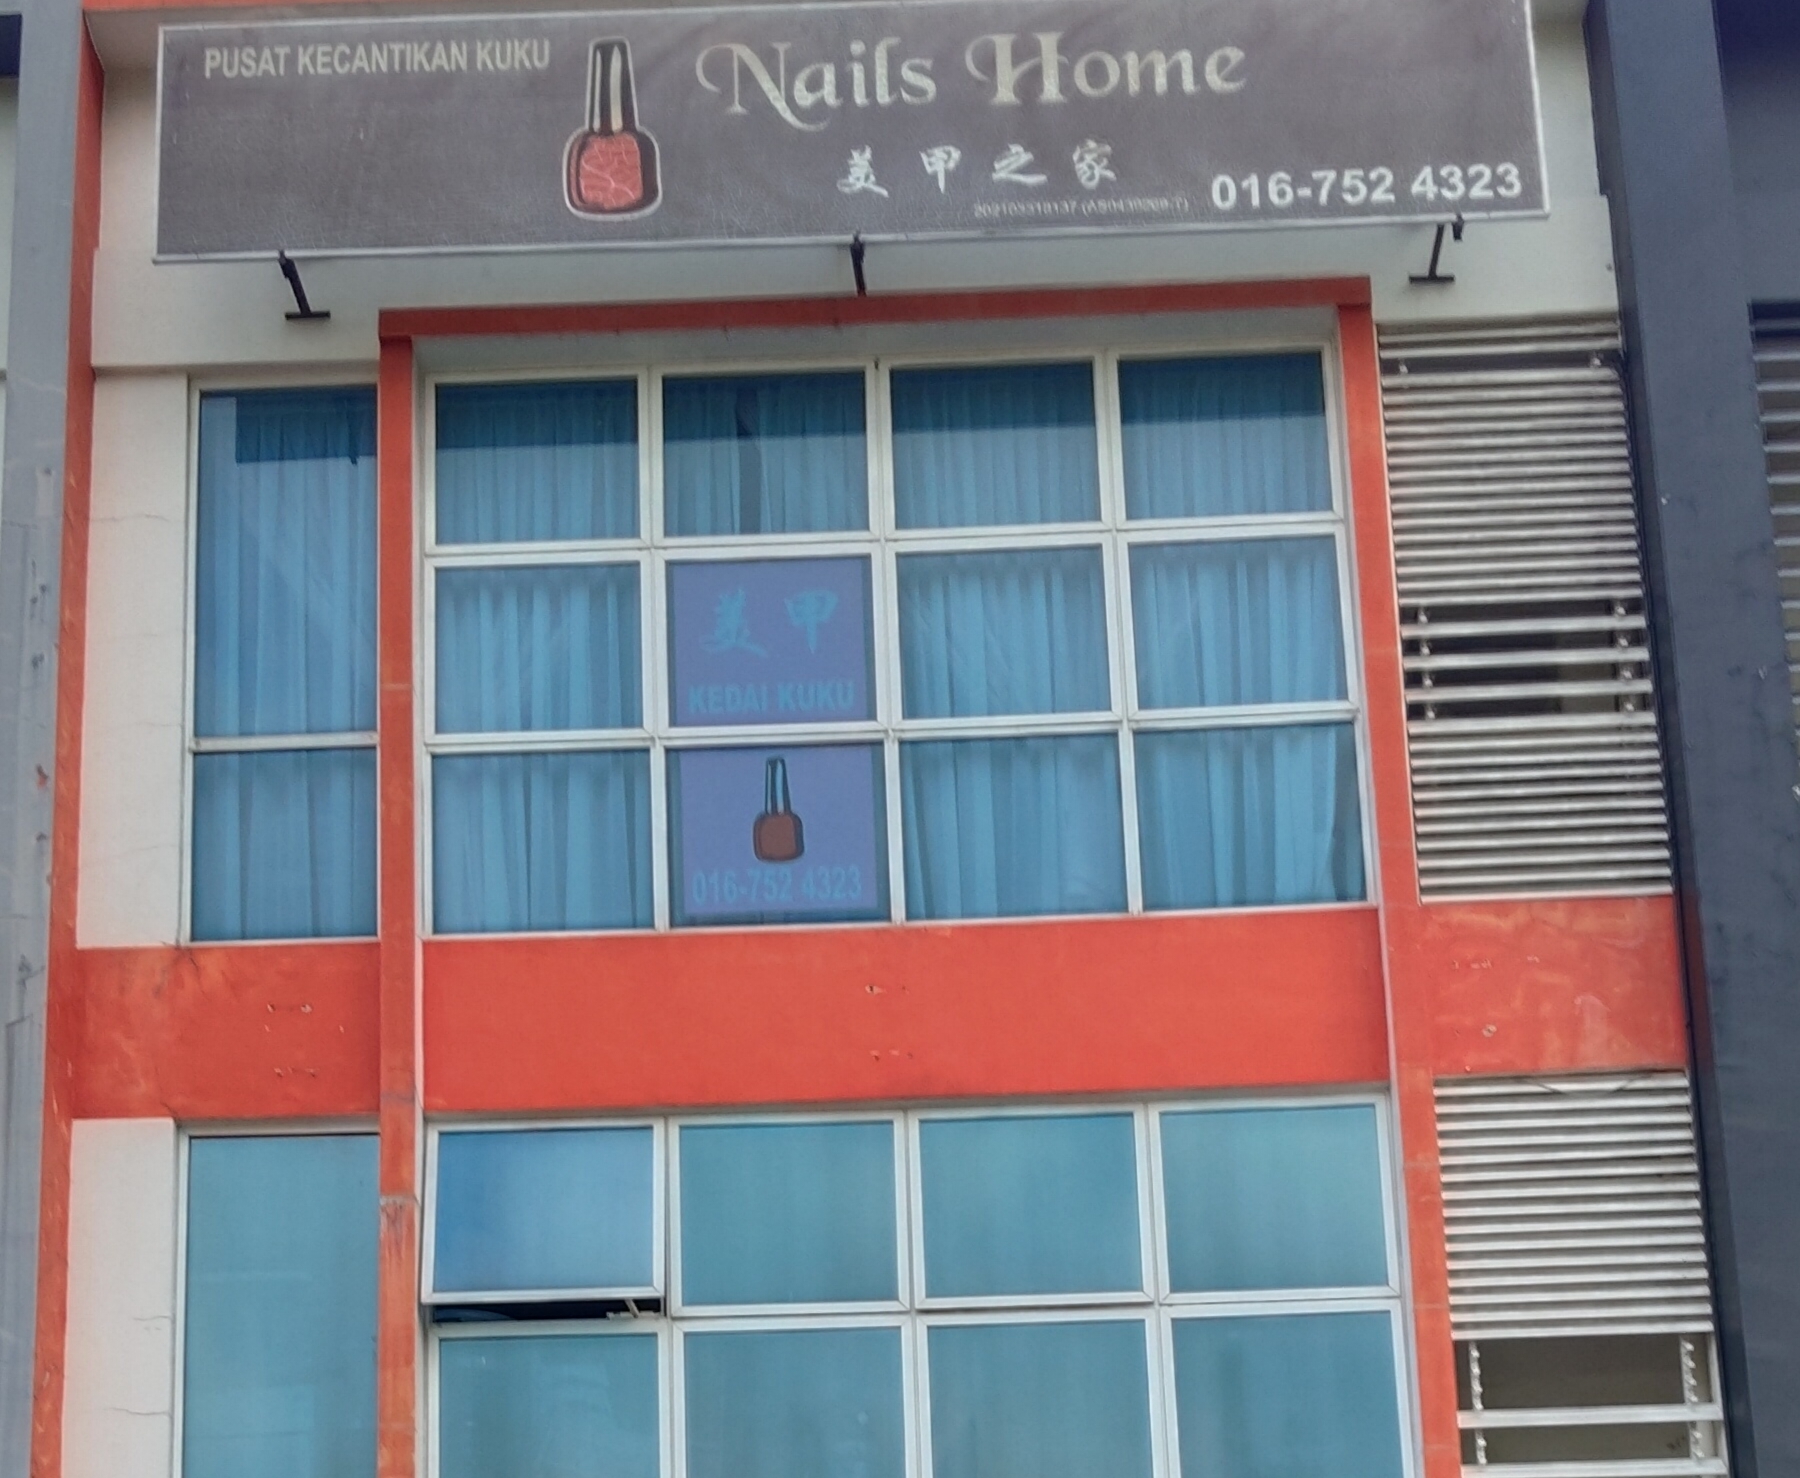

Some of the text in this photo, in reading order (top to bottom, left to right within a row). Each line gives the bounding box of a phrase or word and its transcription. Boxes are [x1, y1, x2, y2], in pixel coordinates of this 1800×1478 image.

[204, 37, 550, 79] PUSAT KECANTIKAN KUKU
[695, 31, 1247, 132] Nails Home
[836, 137, 1117, 199] 美甲之家
[1211, 163, 1523, 210] 016-752 4323
[687, 680, 855, 715] KEDAI KUKU
[691, 865, 862, 904] 016-752 4323
